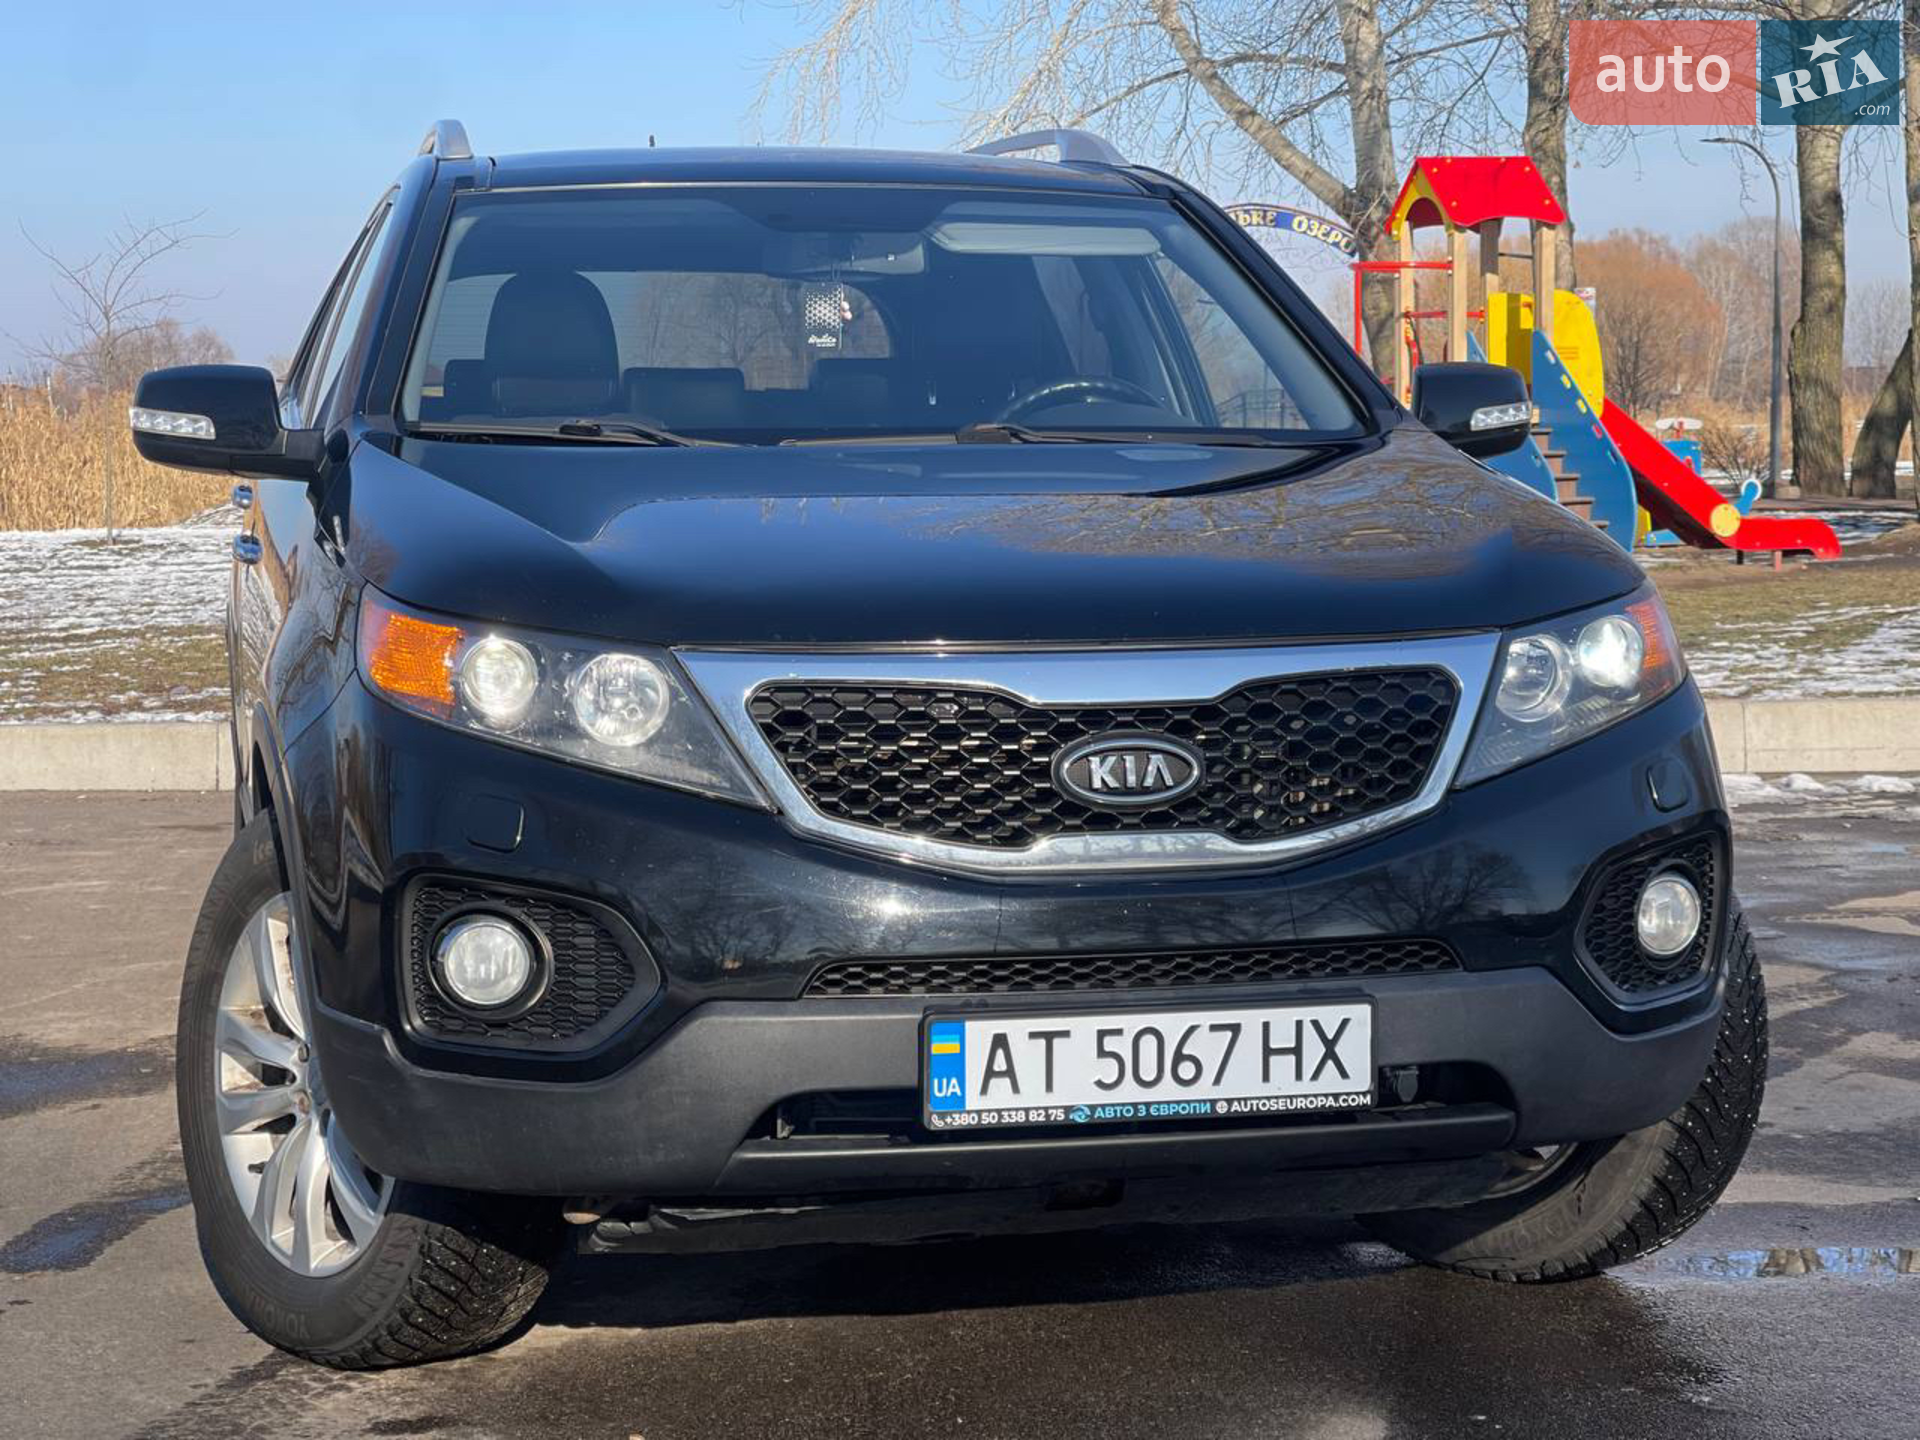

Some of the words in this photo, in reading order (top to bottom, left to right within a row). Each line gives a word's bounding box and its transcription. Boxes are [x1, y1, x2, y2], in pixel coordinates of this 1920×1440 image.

[1087, 754, 1174, 789] KIA
[980, 1032, 1071, 1096] AT
[1093, 1022, 1242, 1091] 5067
[1261, 1017, 1352, 1083] HX
[933, 1077, 961, 1097] UA
[1094, 1104, 1134, 1119] АВТО
[1150, 1102, 1211, 1116] ЄВРОПИ
[1230, 1093, 1371, 1113] AUTOSEUROPA.COM
[944, 1112, 978, 1126] +380
[981, 1112, 998, 1124] 50
[1001, 1110, 1025, 1123] 338
[1029, 1109, 1046, 1121] 82
[1049, 1108, 1065, 1121] 75
